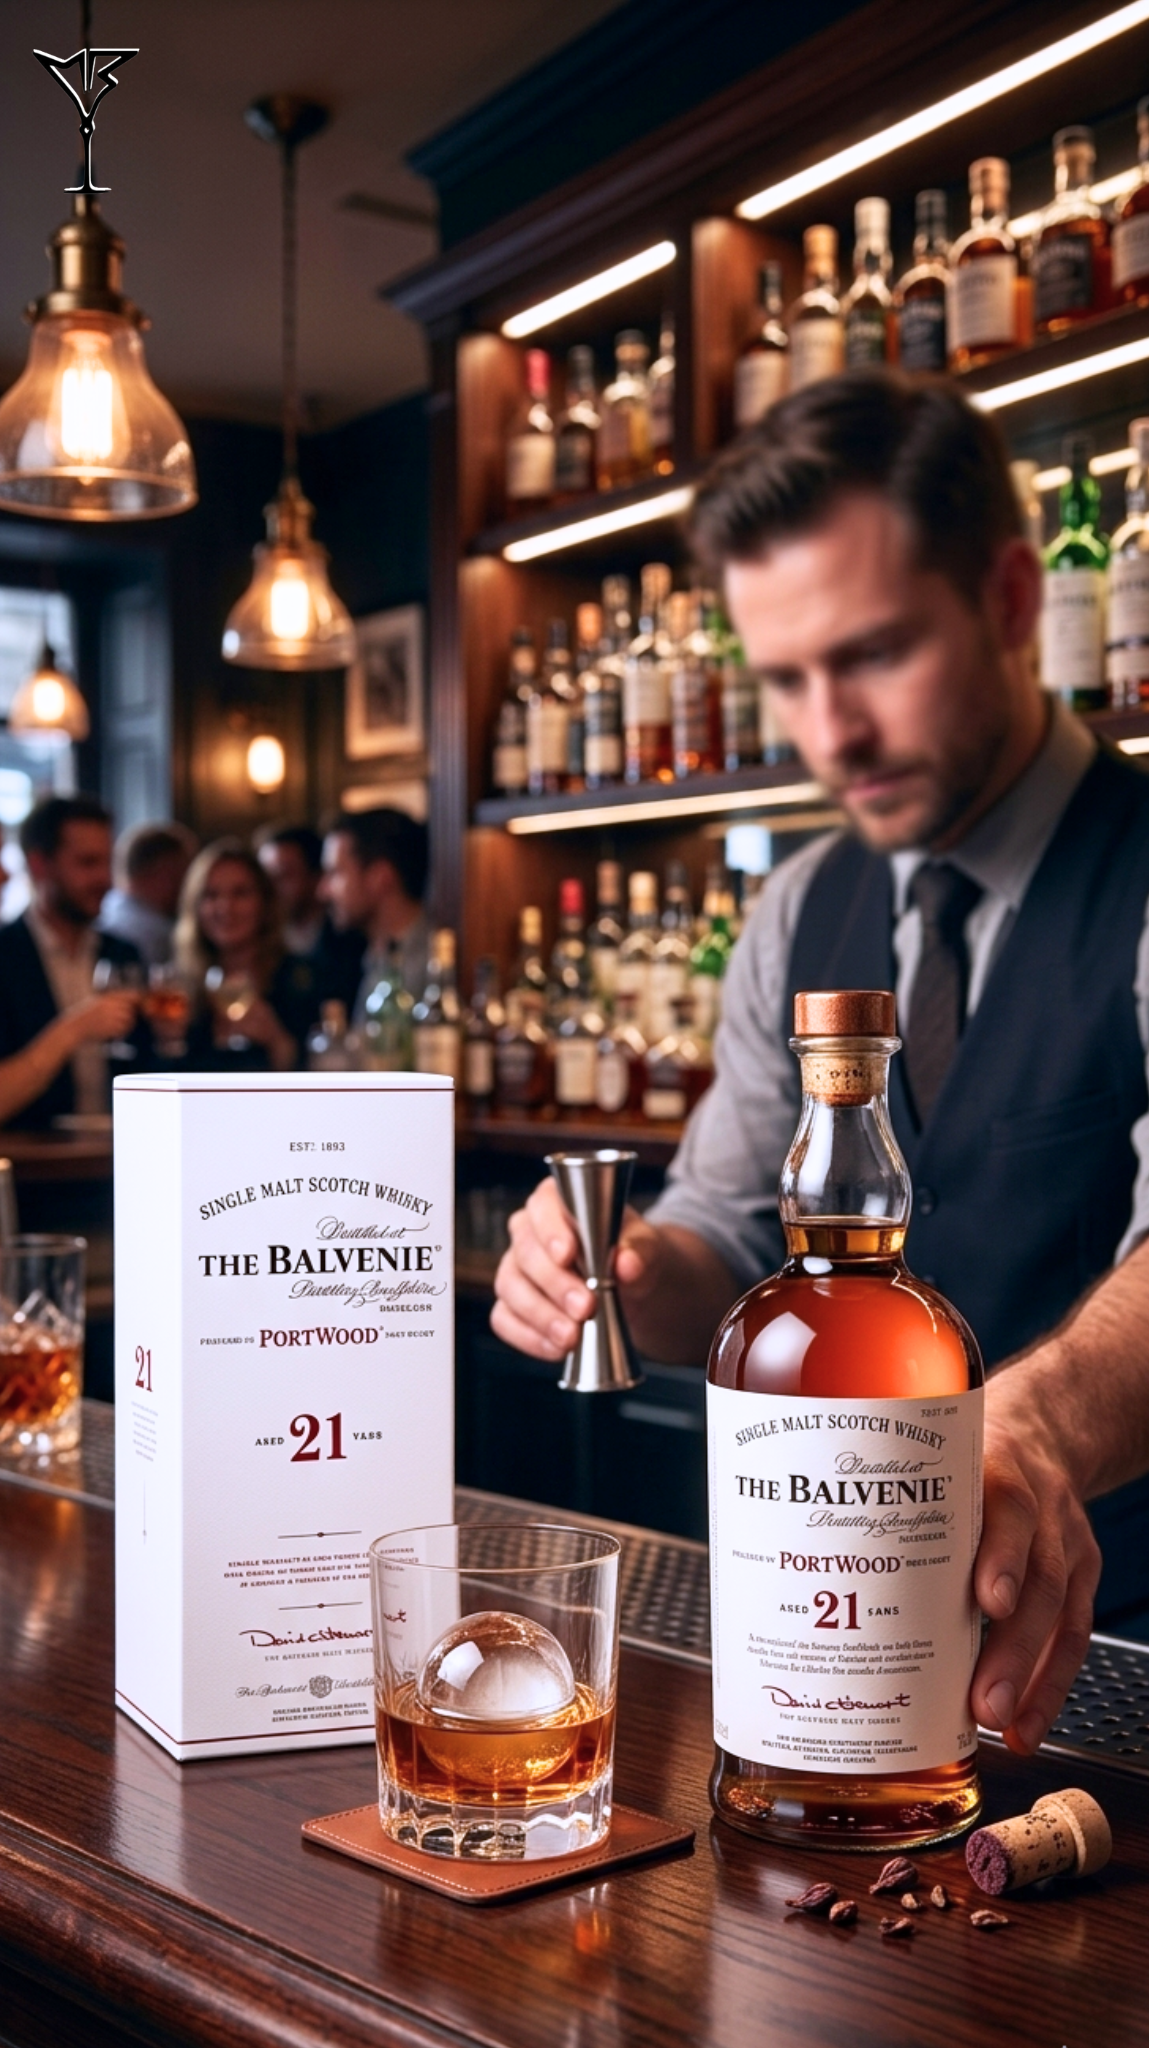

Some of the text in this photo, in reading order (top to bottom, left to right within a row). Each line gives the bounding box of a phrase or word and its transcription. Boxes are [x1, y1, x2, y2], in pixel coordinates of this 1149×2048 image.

[321, 1141, 345, 1152] 1893
[199, 1186, 257, 1221] SINGLE
[260, 1178, 304, 1199] MALT
[308, 1176, 370, 1197] SCOTCH
[198, 1254, 259, 1277] THE
[135, 1345, 153, 1393] 21
[289, 1412, 348, 1462] 21
[735, 1413, 947, 1451] SINGLE MALT SCOTCH WHISKY
[735, 1475, 781, 1502] THE
[813, 1590, 862, 1630] 21
